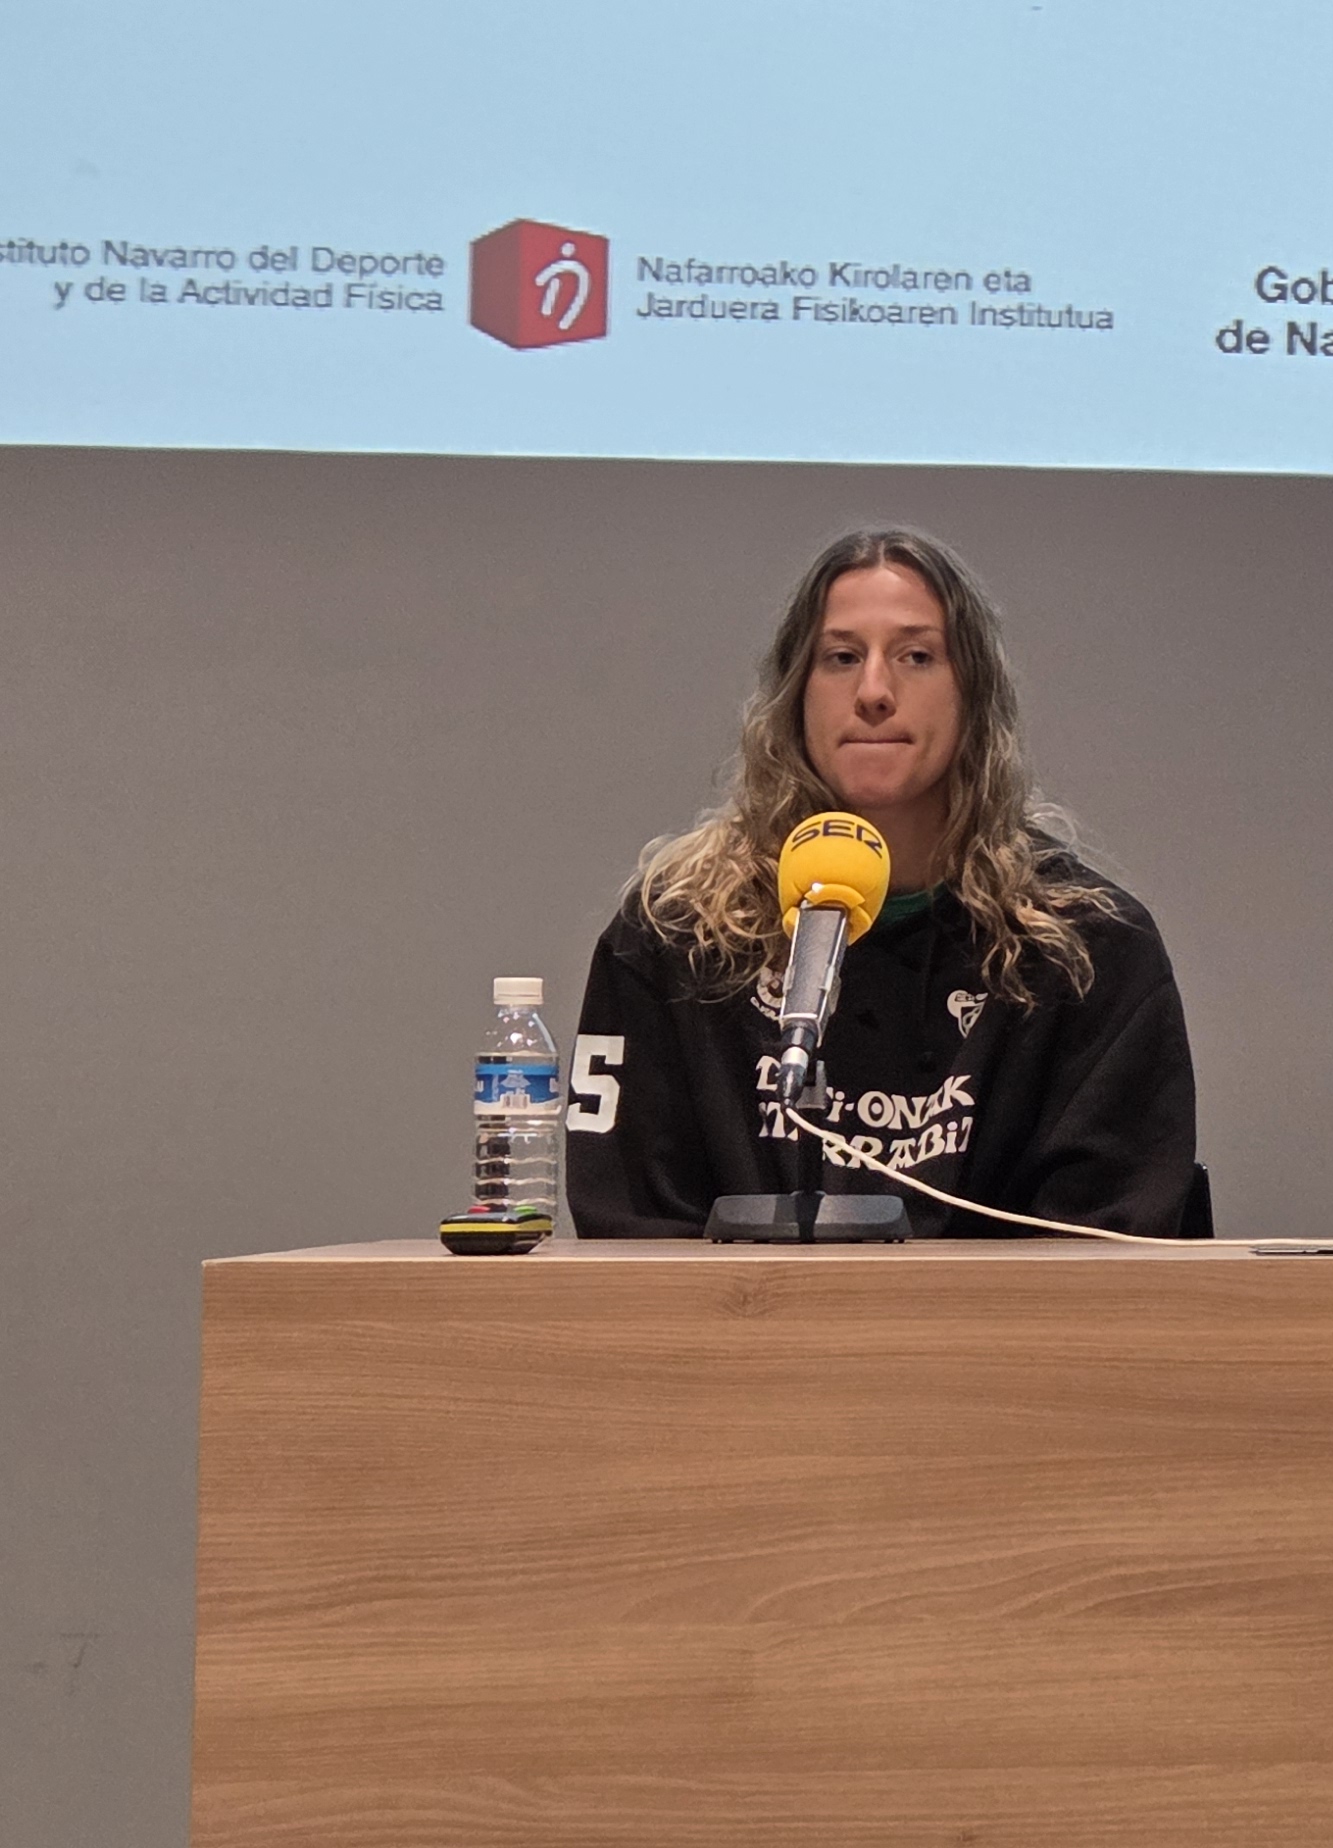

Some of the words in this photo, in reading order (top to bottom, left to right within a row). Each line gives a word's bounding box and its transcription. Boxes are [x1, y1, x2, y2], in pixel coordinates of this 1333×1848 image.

[103, 240, 235, 270] Navarro
[249, 244, 297, 271] del
[311, 246, 444, 280] Deporte
[636, 256, 816, 289] Nafarroako
[828, 261, 972, 293] Kirolaren
[983, 269, 1031, 293] eta
[54, 281, 74, 310] y
[85, 276, 126, 302] de
[140, 278, 167, 303] la
[178, 279, 333, 310] Actividad
[636, 292, 780, 322] Jarduera
[793, 295, 957, 326] Fisikoaren
[970, 301, 1113, 330] Institutua
[1215, 324, 1270, 356] de
[790, 819, 883, 859] SER
[566, 1034, 624, 1133] 5
